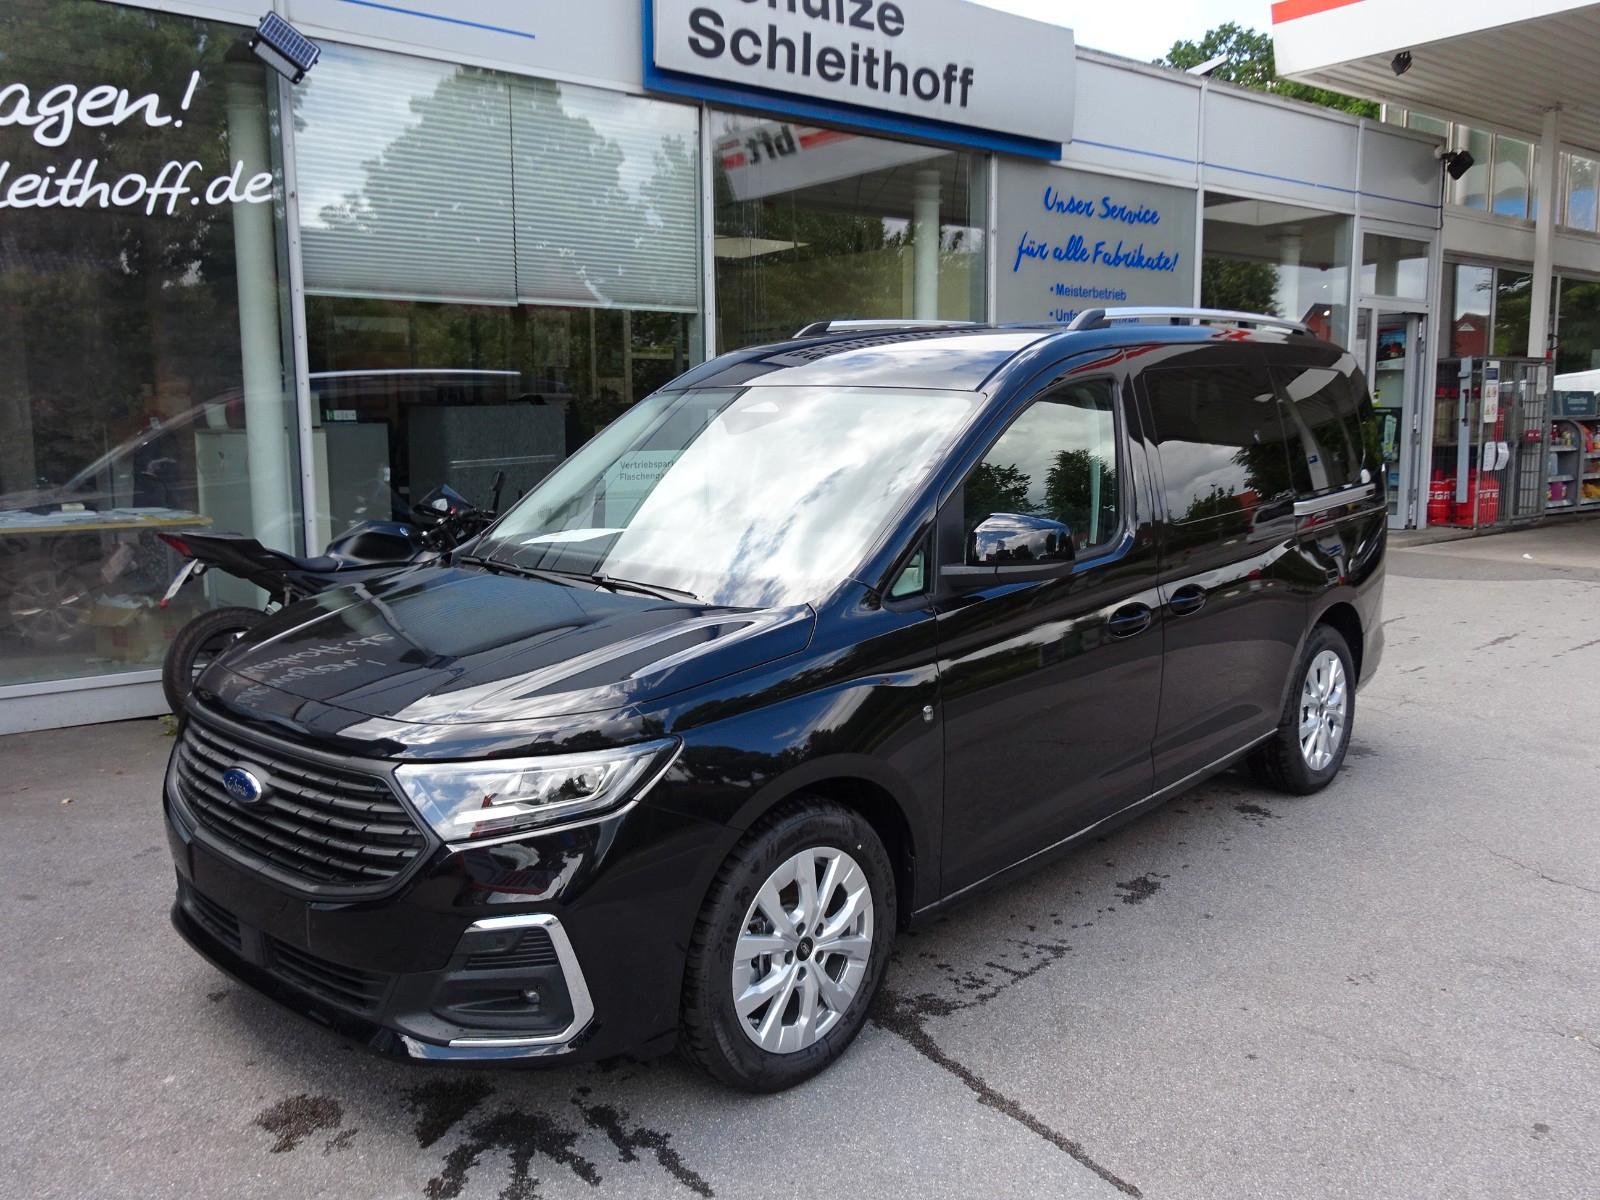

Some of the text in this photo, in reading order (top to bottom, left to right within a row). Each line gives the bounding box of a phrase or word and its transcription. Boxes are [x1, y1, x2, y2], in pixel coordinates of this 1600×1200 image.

[688, 7, 974, 107] Schleithoff
[1044, 186, 1160, 225] Unser Service
[1013, 231, 1179, 273] für alle Fabrikate!
[1055, 283, 1127, 301] Meisterbetrieb
